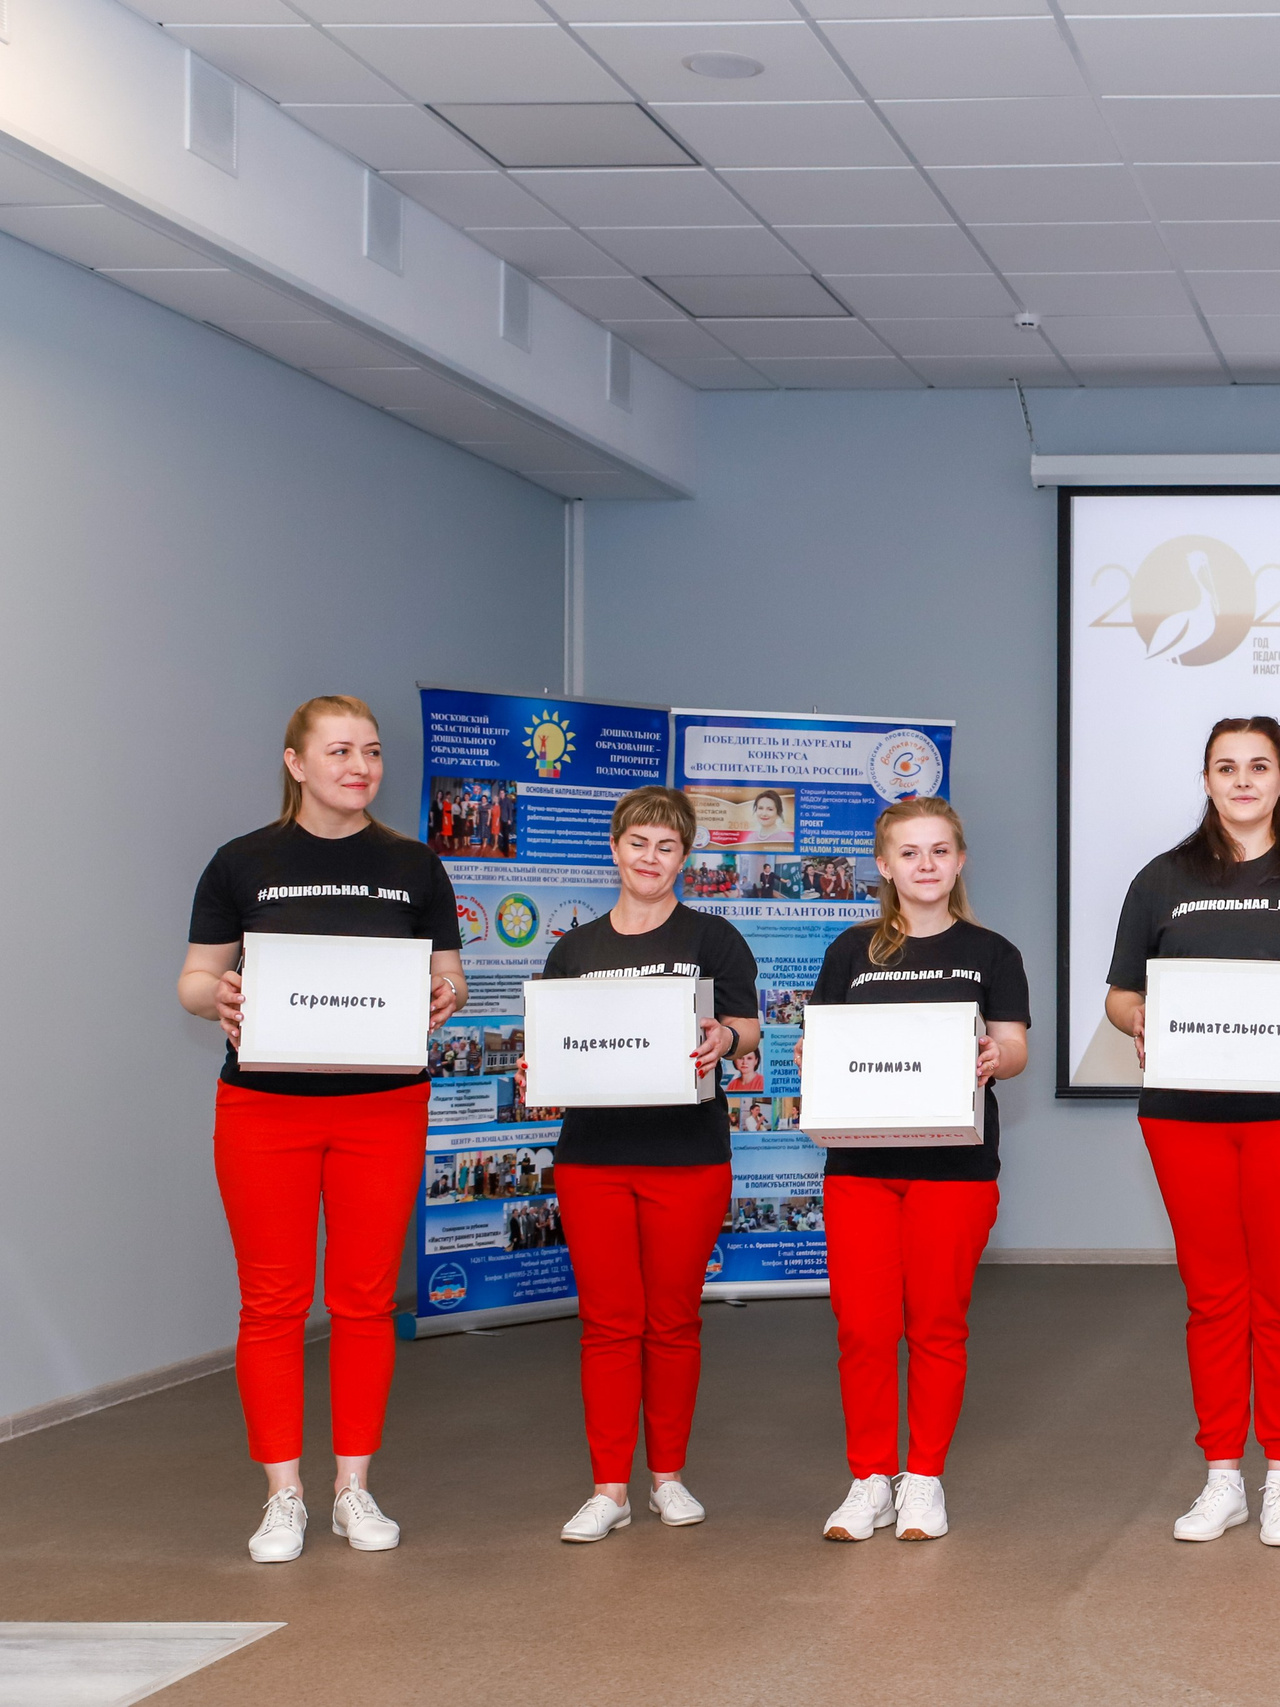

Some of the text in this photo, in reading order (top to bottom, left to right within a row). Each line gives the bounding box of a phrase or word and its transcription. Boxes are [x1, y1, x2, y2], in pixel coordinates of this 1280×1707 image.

[1253, 637, 1269, 649] ГОД
[1253, 664, 1259, 675] И
[431, 713, 489, 724] МОСКОВСКИЙ
[431, 724, 510, 736] ОБЛАСТНОЙ ЦЕНТР
[600, 728, 662, 740] ДОШКОЛЬНОЕ
[431, 735, 496, 746] ДОШКОЛЬНОГО
[704, 735, 852, 749] ПОБЕДИТЕЛЬ И ЛАУРЕАТЫ
[431, 746, 489, 756] ОБРАЗОВАНИЯ
[596, 741, 655, 753] ОБРАЗОВАНИЕ
[884, 732, 940, 766] ПРОФЕССИОНАЛЬНЫЙ
[610, 755, 660, 766] ПРИОРИТЕТ
[748, 750, 808, 760] КОНКУРСА
[431, 756, 500, 767] «СОДРУЖЕСТВО»
[596, 767, 659, 778] ПОДМОСКОВЬЯ
[690, 763, 864, 776] «ВОСПИТАТЕЛЬ ГОДА РОССИИ»
[526, 786, 554, 795] ОСНОВНЫЕ
[555, 788, 592, 797] НАПРАВЛЕНИЯ
[800, 828, 820, 836] «Наука
[800, 836, 815, 844] «ВСЁ
[800, 846, 832, 854] НАЧАЛОМ
[484, 866, 536, 874] РЕГИОНАЛЬНЫЙ
[498, 875, 542, 883] РЕАЛИЗАЦИИ
[560, 876, 608, 884] ДОШКОЛЬНОГО
[258, 884, 411, 904] #ДОШКОЛЬНАЯ_ЛИГА
[766, 906, 835, 917] ТАЛАНТОВ
[476, 958, 528, 966] РЕГИОНАЛЬНЫЙ
[851, 969, 982, 989] #ДОШКОЛЬНАЯ_ЛИГА
[290, 992, 386, 1009] Скромность
[564, 1036, 650, 1052] Надежность
[849, 1060, 922, 1074] Оптимизм
[772, 1077, 790, 1085] ДЕТЕЙ
[770, 1086, 800, 1094] ЦВЕТНЫМ
[451, 1132, 560, 1146] ЦЕНТР ПЛОЩАДКА МЕЖДУНАРОД
